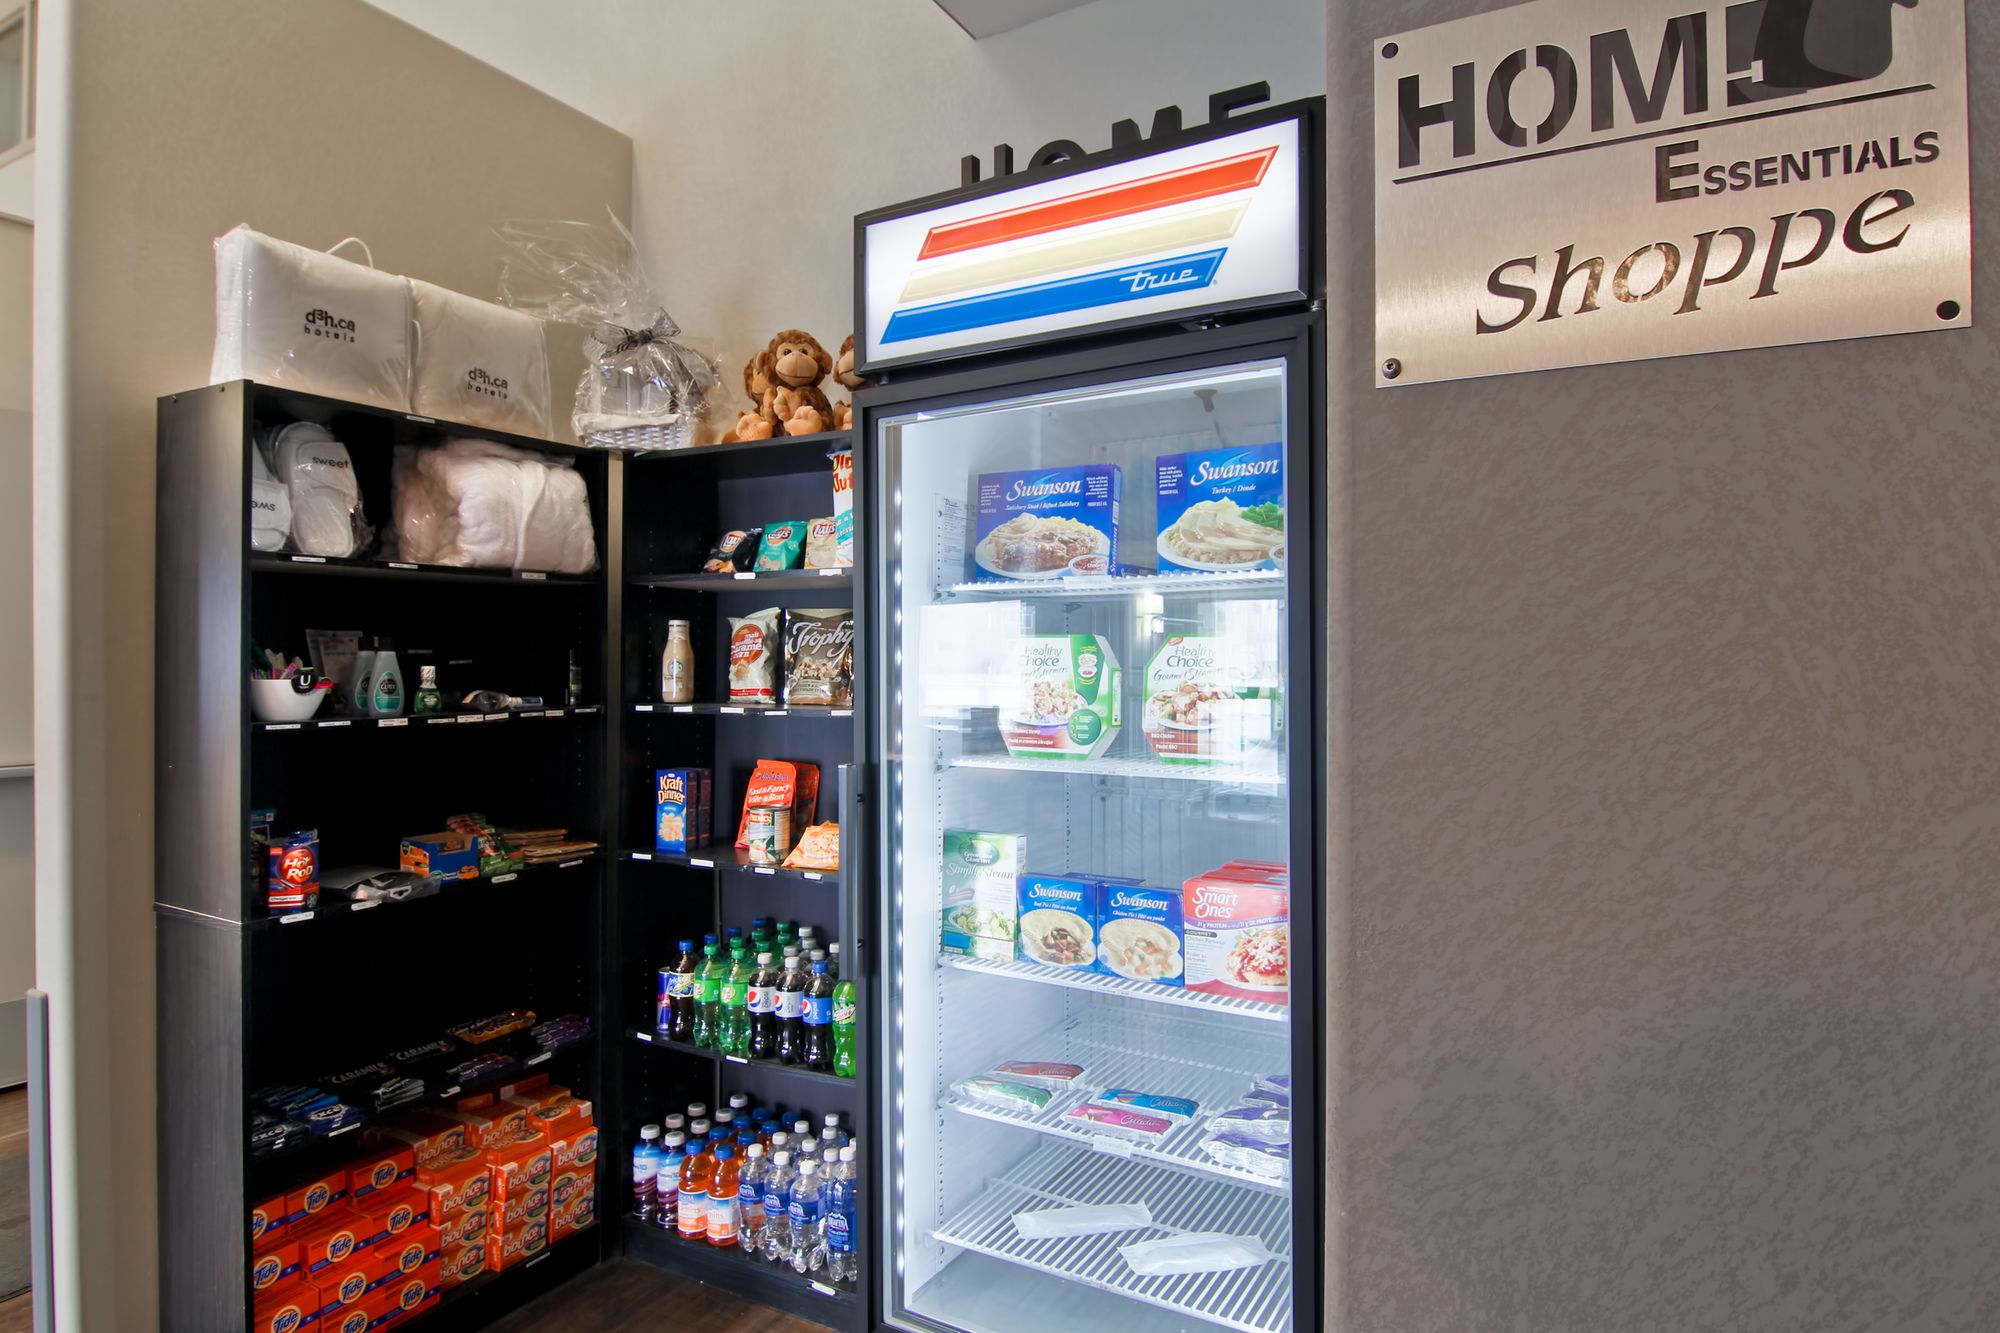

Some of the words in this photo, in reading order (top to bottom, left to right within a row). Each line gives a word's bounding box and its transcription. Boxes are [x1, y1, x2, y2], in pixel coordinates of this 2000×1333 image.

[1476, 188, 1916, 335] Shoppe
[1120, 269, 1199, 292] true
[304, 325, 356, 344] hotels
[467, 382, 509, 400] hotels
[312, 456, 349, 468] sweet
[1190, 459, 1280, 486] Swanson
[1005, 480, 1081, 502] Swanson
[787, 620, 854, 658] Trophy
[1021, 655, 1060, 667] hoice
[1166, 655, 1214, 668] Choice
[659, 776, 684, 793] Kraft
[657, 790, 685, 805] Dinner
[1029, 884, 1082, 902] Swanson
[1110, 892, 1168, 911] Swanson
[1192, 886, 1239, 906] Smart
[1195, 902, 1231, 919] Ones
[396, 1040, 447, 1061] CARAMILK
[484, 1119, 520, 1145] bounce
[558, 1139, 592, 1165] bounce
[375, 1168, 395, 1185] Tide
[508, 1161, 545, 1191] bounce
[307, 1190, 328, 1211] Tide
[443, 1182, 481, 1212] bounce
[506, 1195, 543, 1223] bounce
[555, 1202, 588, 1229] bounce
[389, 1213, 411, 1231] Tide
[441, 1217, 480, 1248] bounce
[329, 1237, 352, 1258] Tide
[504, 1229, 539, 1256] bounce
[400, 1249, 422, 1267] Tide
[440, 1249, 477, 1279] bounce
[255, 1262, 278, 1287] Tide
[341, 1279, 365, 1301] Tide
[402, 1288, 423, 1307] Tide
[274, 1312, 299, 1333] Tide
[343, 1317, 366, 1333] Tide
